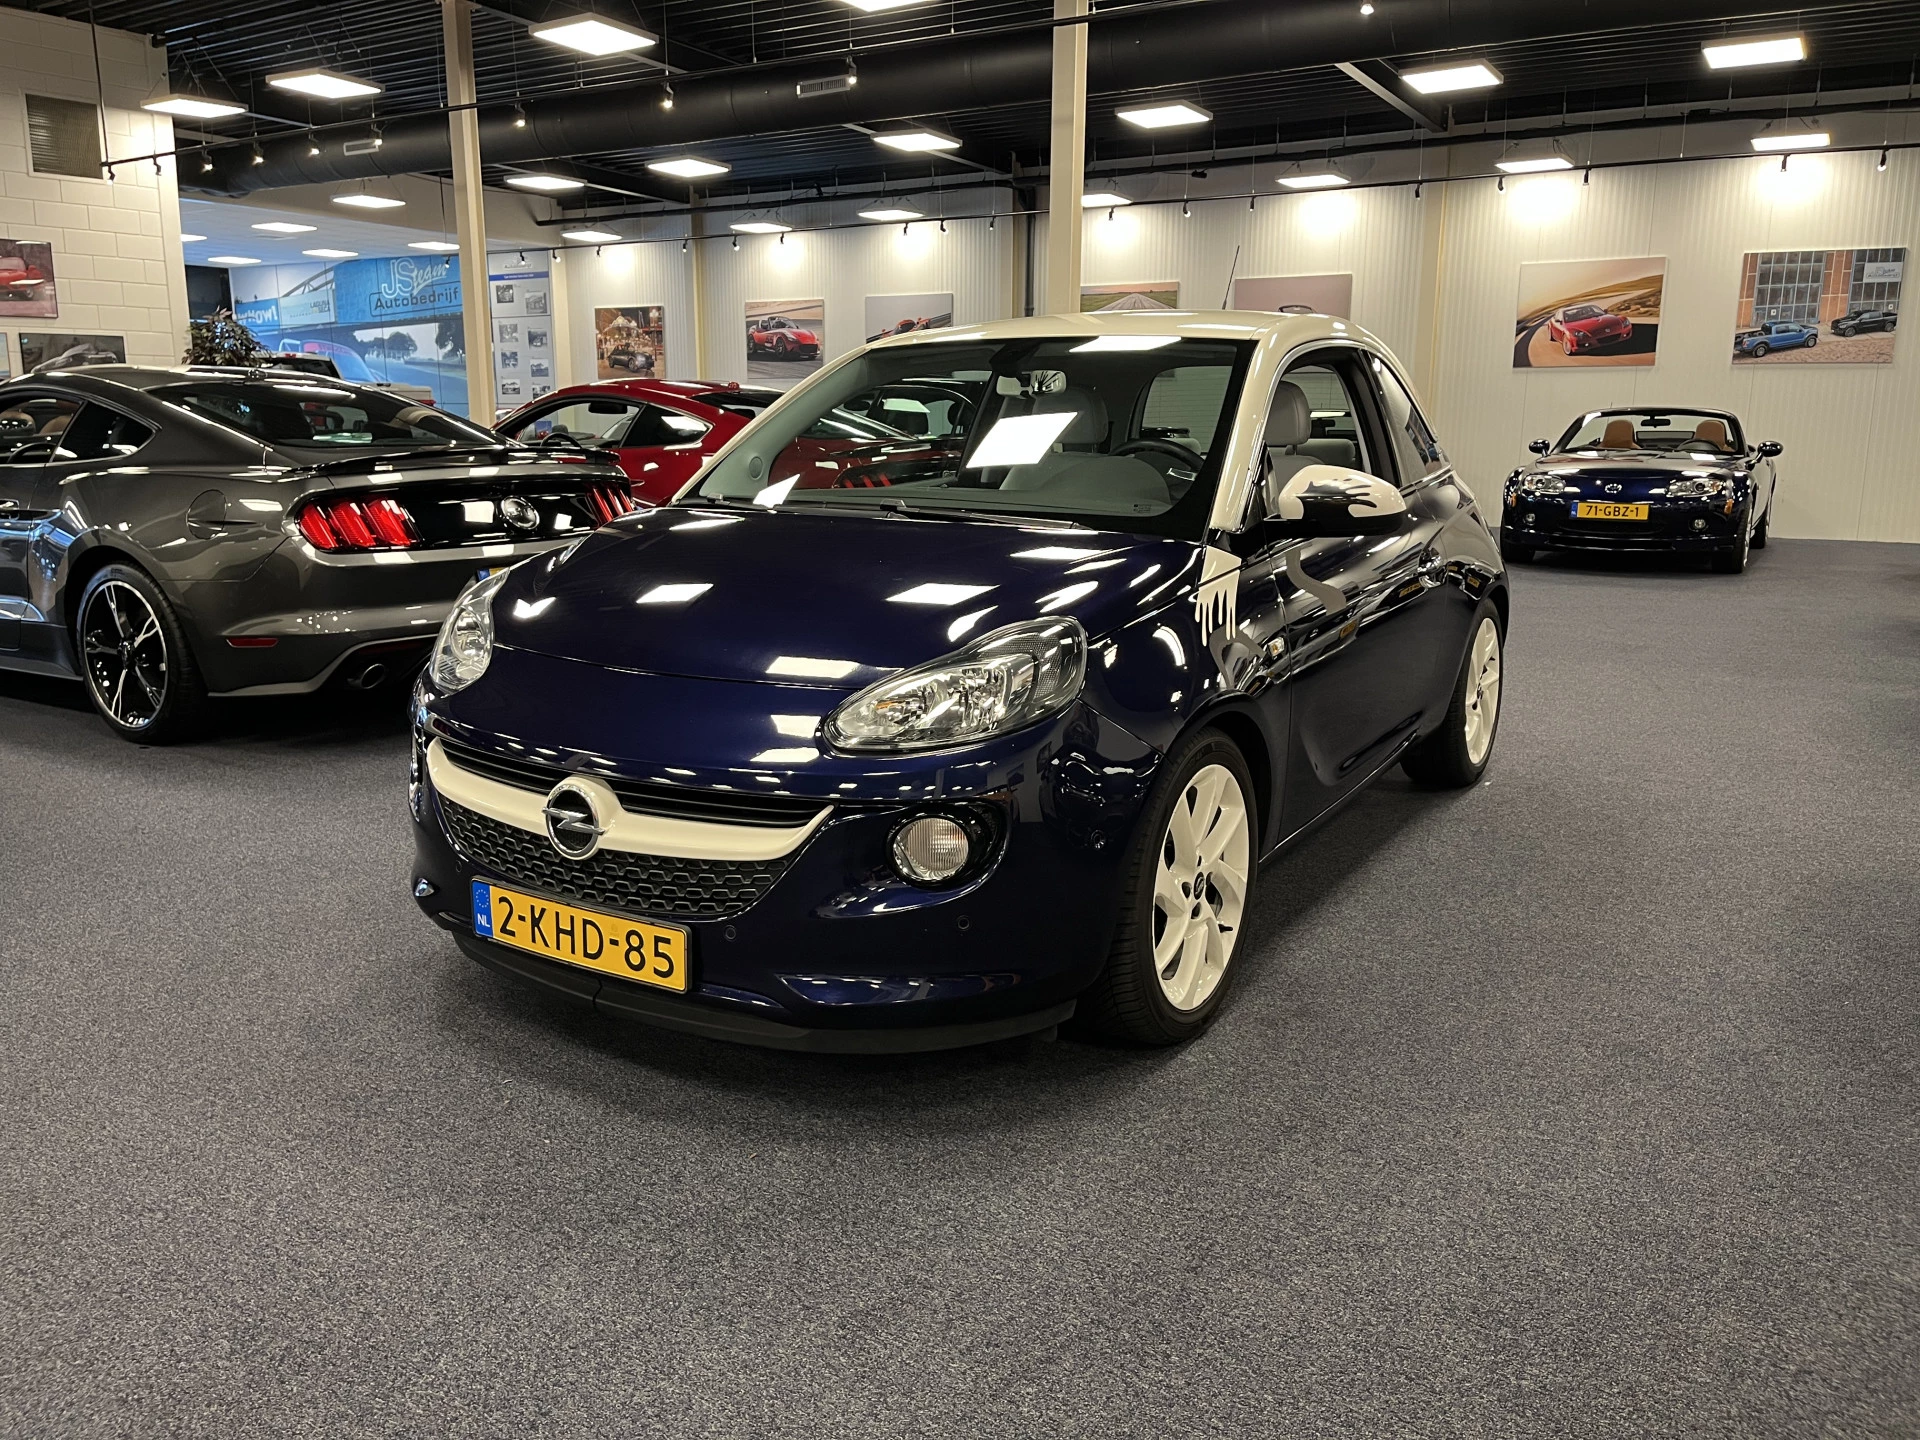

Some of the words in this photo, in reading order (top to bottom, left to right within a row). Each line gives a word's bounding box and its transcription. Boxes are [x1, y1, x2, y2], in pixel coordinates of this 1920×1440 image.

[374, 286, 459, 311] Autobedrijf
[1585, 505, 1639, 518] 71-GBZ-1
[477, 913, 491, 928] NL
[498, 896, 674, 979] 2-KHD-85
